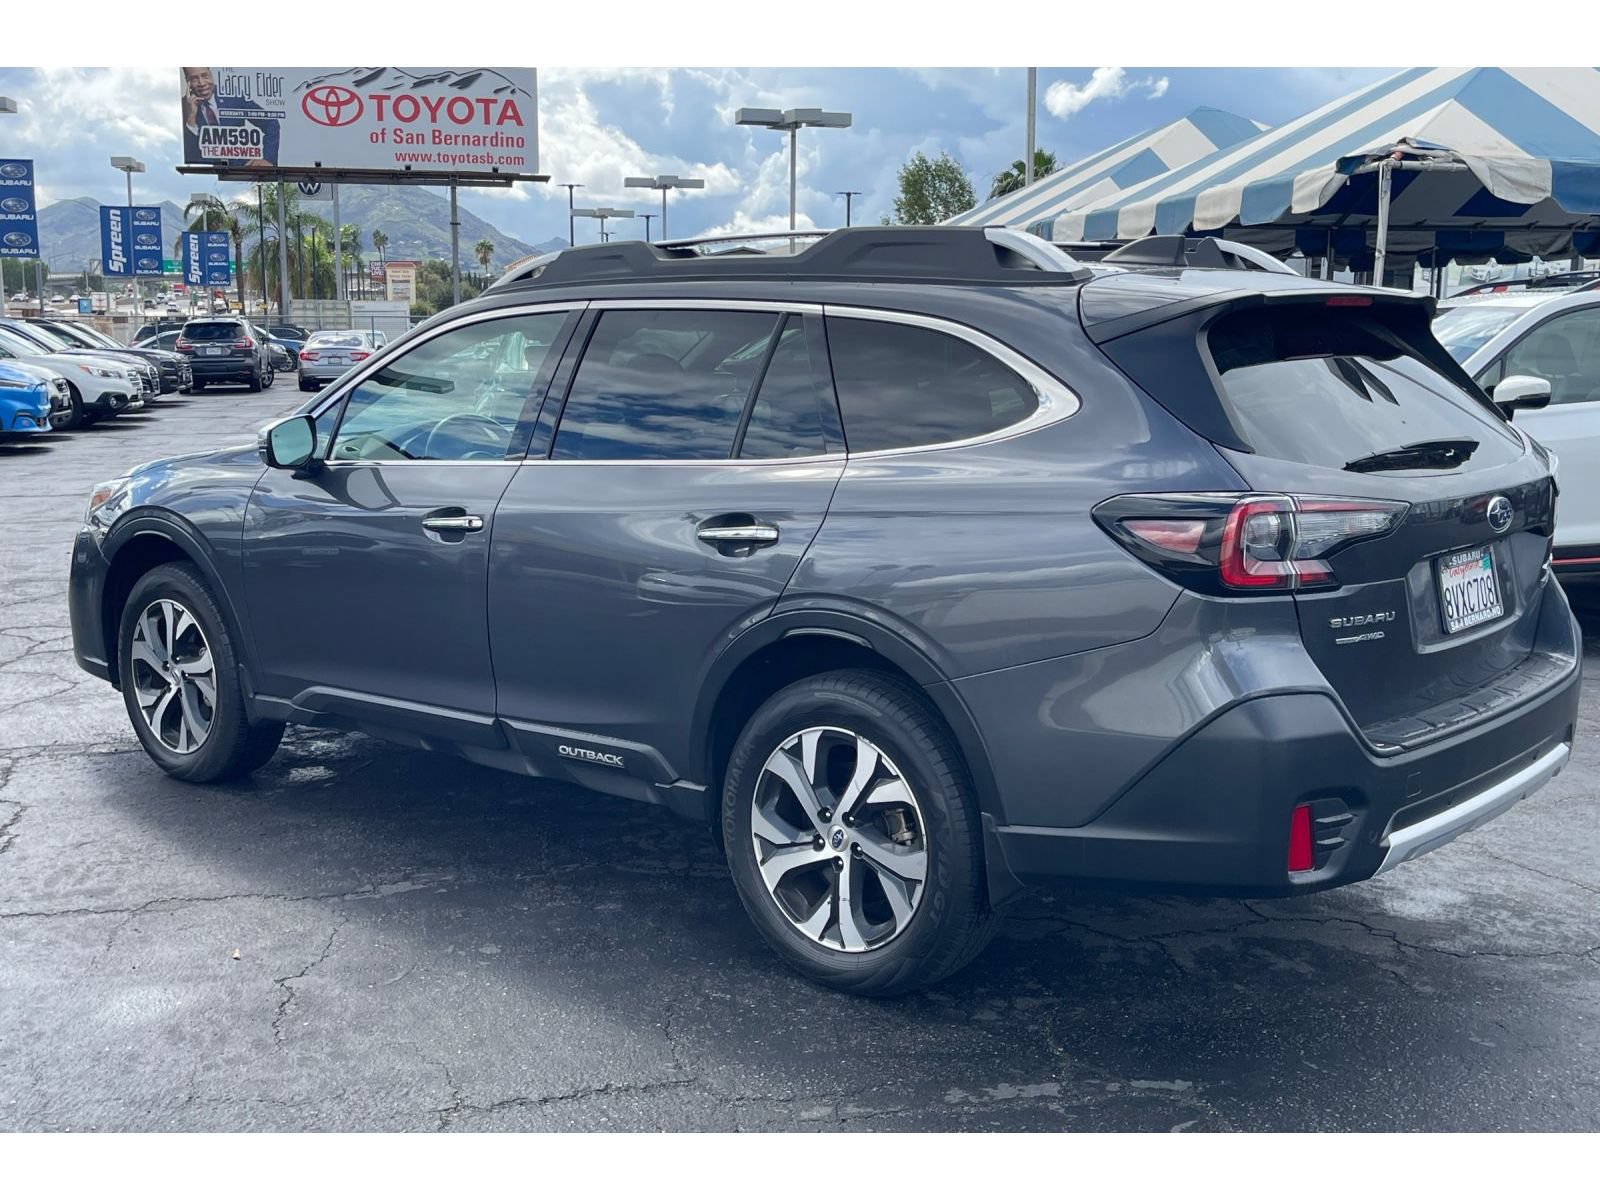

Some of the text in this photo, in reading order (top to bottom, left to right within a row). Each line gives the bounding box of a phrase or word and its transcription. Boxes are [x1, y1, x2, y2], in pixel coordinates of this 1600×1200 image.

[218, 71, 284, 99] Larry Elder
[369, 94, 524, 126] TOYOTA
[201, 128, 261, 146] AM590
[370, 127, 525, 149] of San Bernardino
[202, 146, 261, 157] THE ANSWER
[395, 151, 525, 166] www.toyotasb.com
[109, 209, 127, 273] Spreen
[188, 233, 203, 284] Spreen
[1451, 550, 1481, 565] SUBARU
[1445, 575, 1495, 619] 8VXC708
[1330, 611, 1396, 629] SUBARU
[558, 745, 625, 766] OUTBACK
